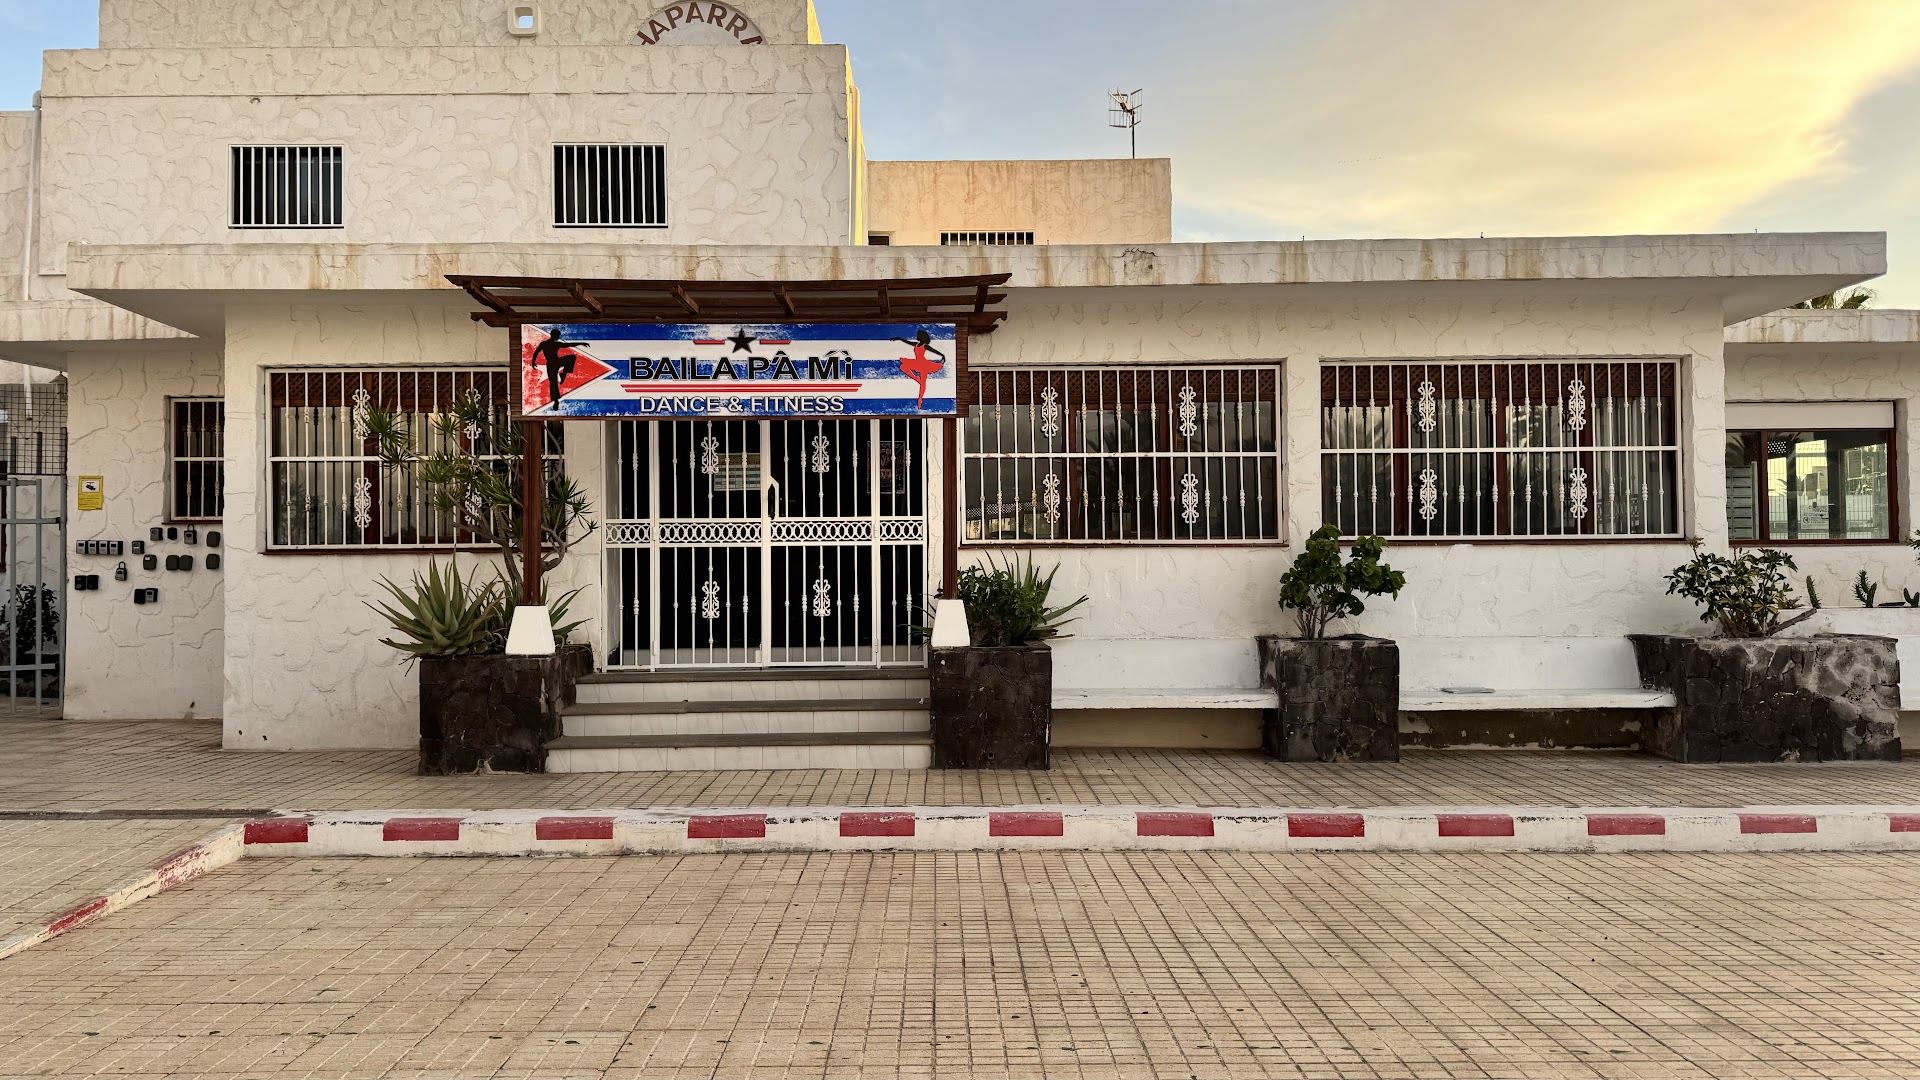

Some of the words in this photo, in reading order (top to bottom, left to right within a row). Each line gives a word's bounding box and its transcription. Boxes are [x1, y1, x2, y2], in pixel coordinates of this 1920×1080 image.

[629, 356, 739, 380] BAILA
[639, 396, 721, 413] DANCE
[727, 396, 744, 413] &
[750, 396, 844, 413] FITNESS
